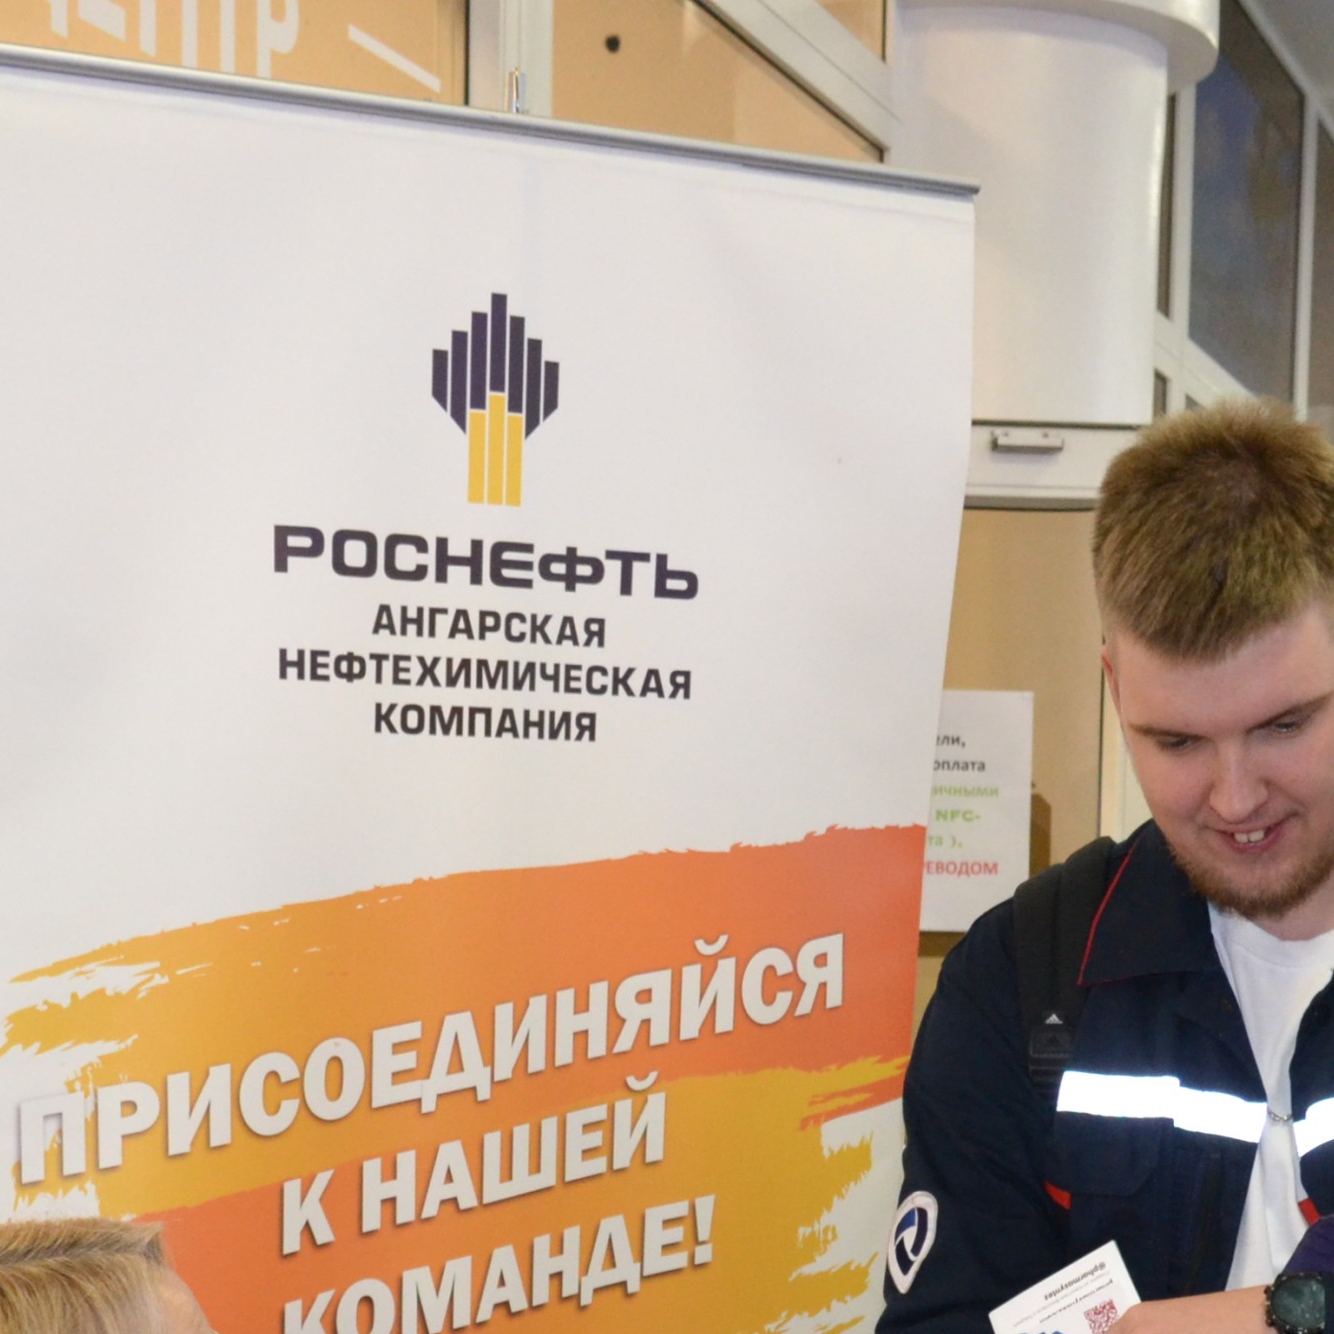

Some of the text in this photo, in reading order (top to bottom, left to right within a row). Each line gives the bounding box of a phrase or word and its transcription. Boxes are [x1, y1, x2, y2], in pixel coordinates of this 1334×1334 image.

[274, 525, 699, 600] РОСНЕФТЬ
[372, 604, 606, 648] АНГАРСКАЯ
[278, 648, 692, 700] НЕФТЕХИМИЧЕСКАЯ
[374, 702, 597, 742] КОМПАНИЯ
[926, 861, 998, 878] ЕВОДОМ
[18, 933, 845, 1184] ПРИСОЕДИНЯЙСЯ
[281, 1073, 666, 1256] К НАШЕЙ
